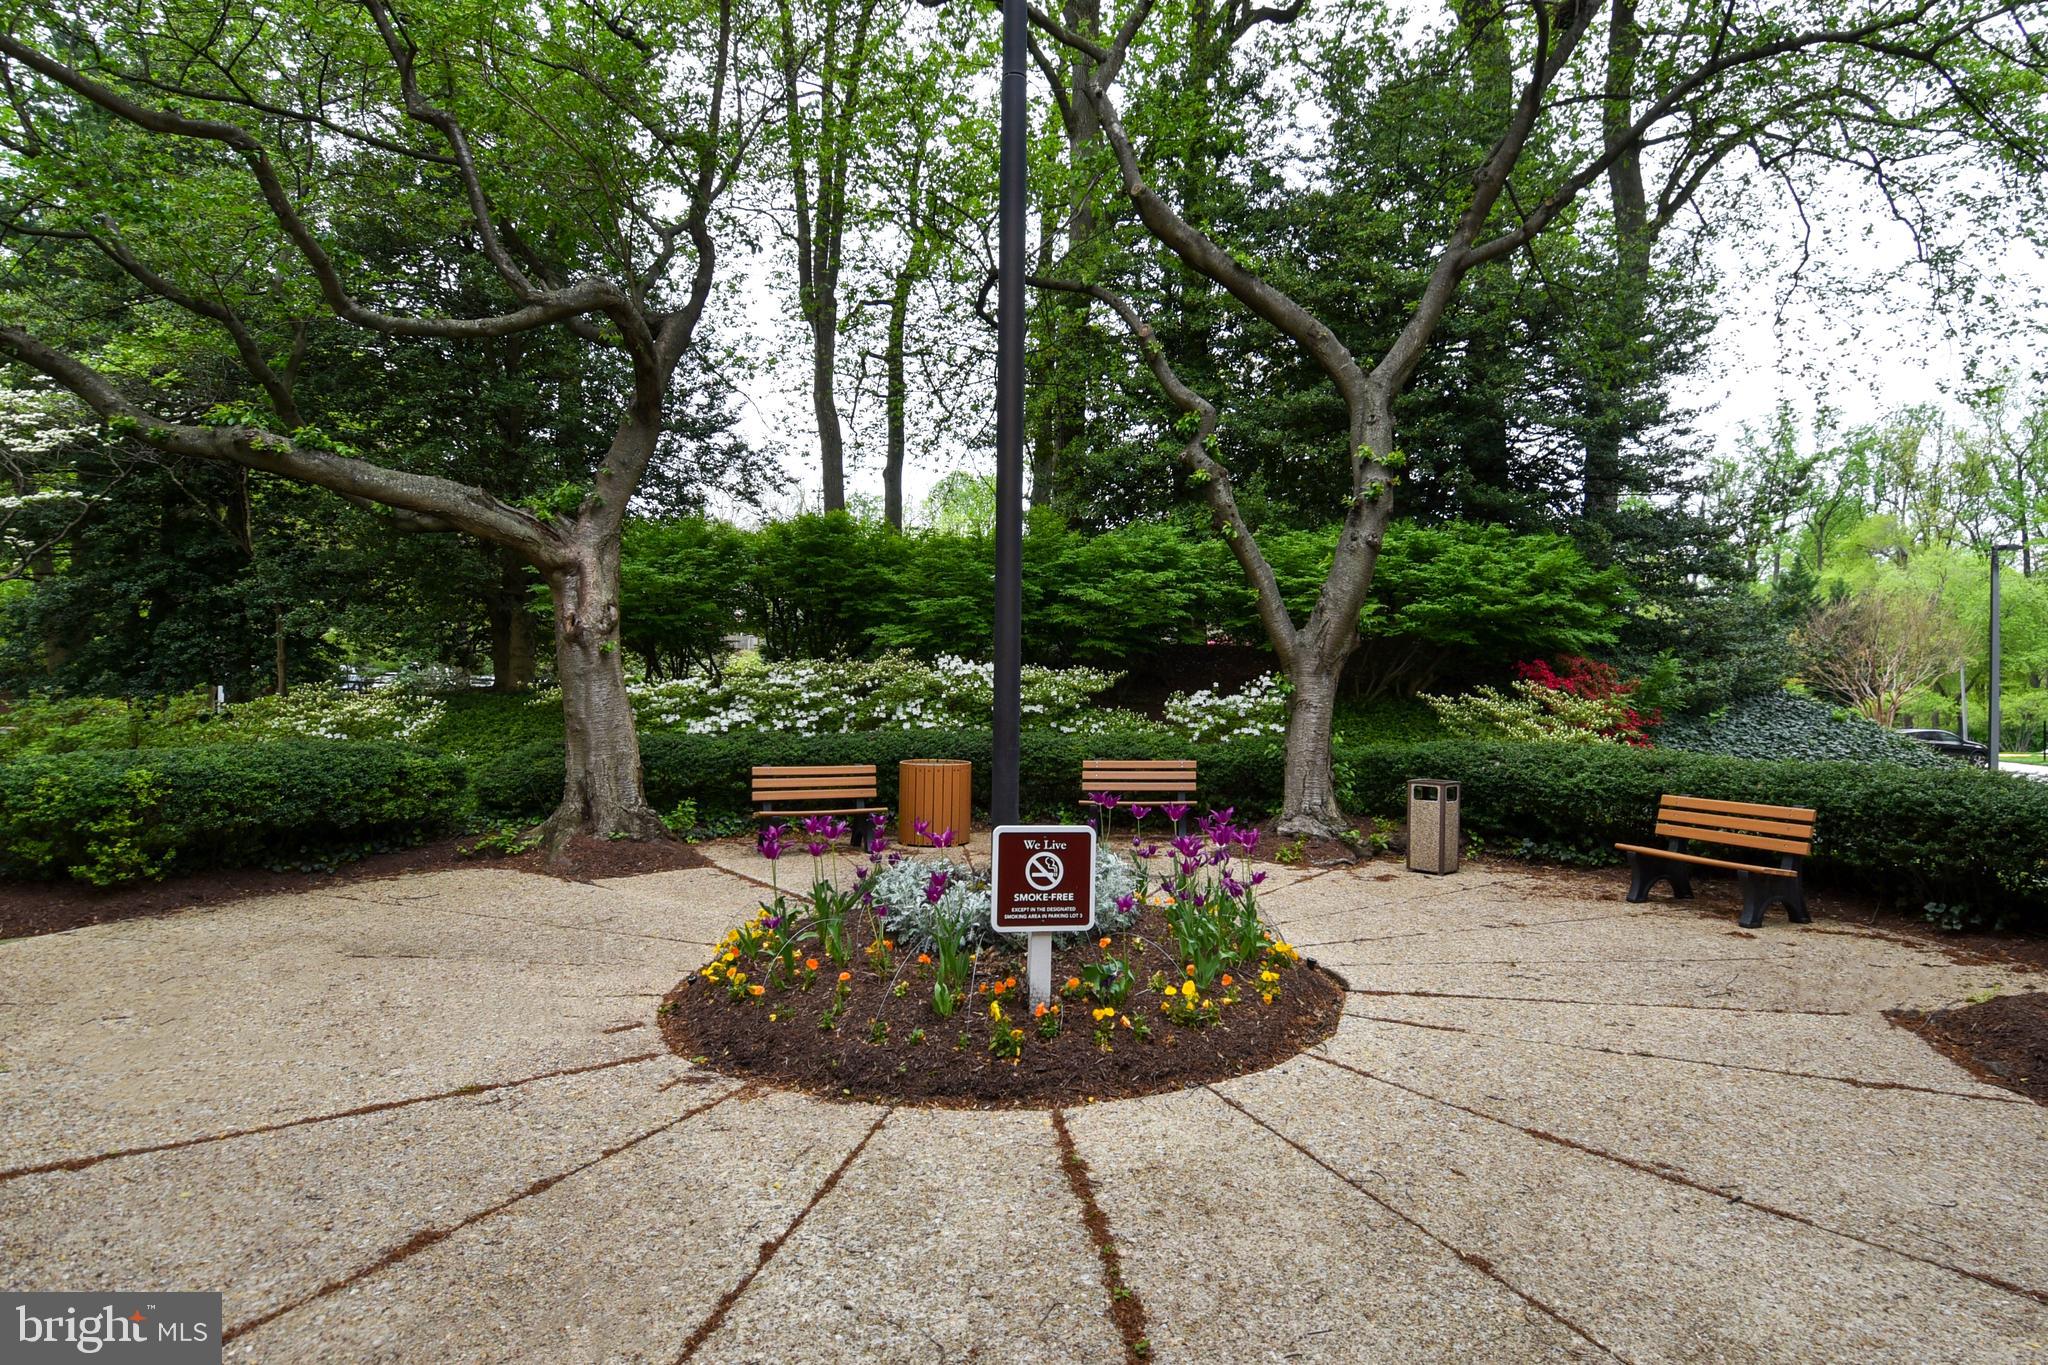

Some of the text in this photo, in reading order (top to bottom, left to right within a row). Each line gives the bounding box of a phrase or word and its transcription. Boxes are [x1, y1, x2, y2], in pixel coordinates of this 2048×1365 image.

[1024, 840, 1067, 850] We Live
[1013, 893, 1074, 902] SMOKE-FREE
